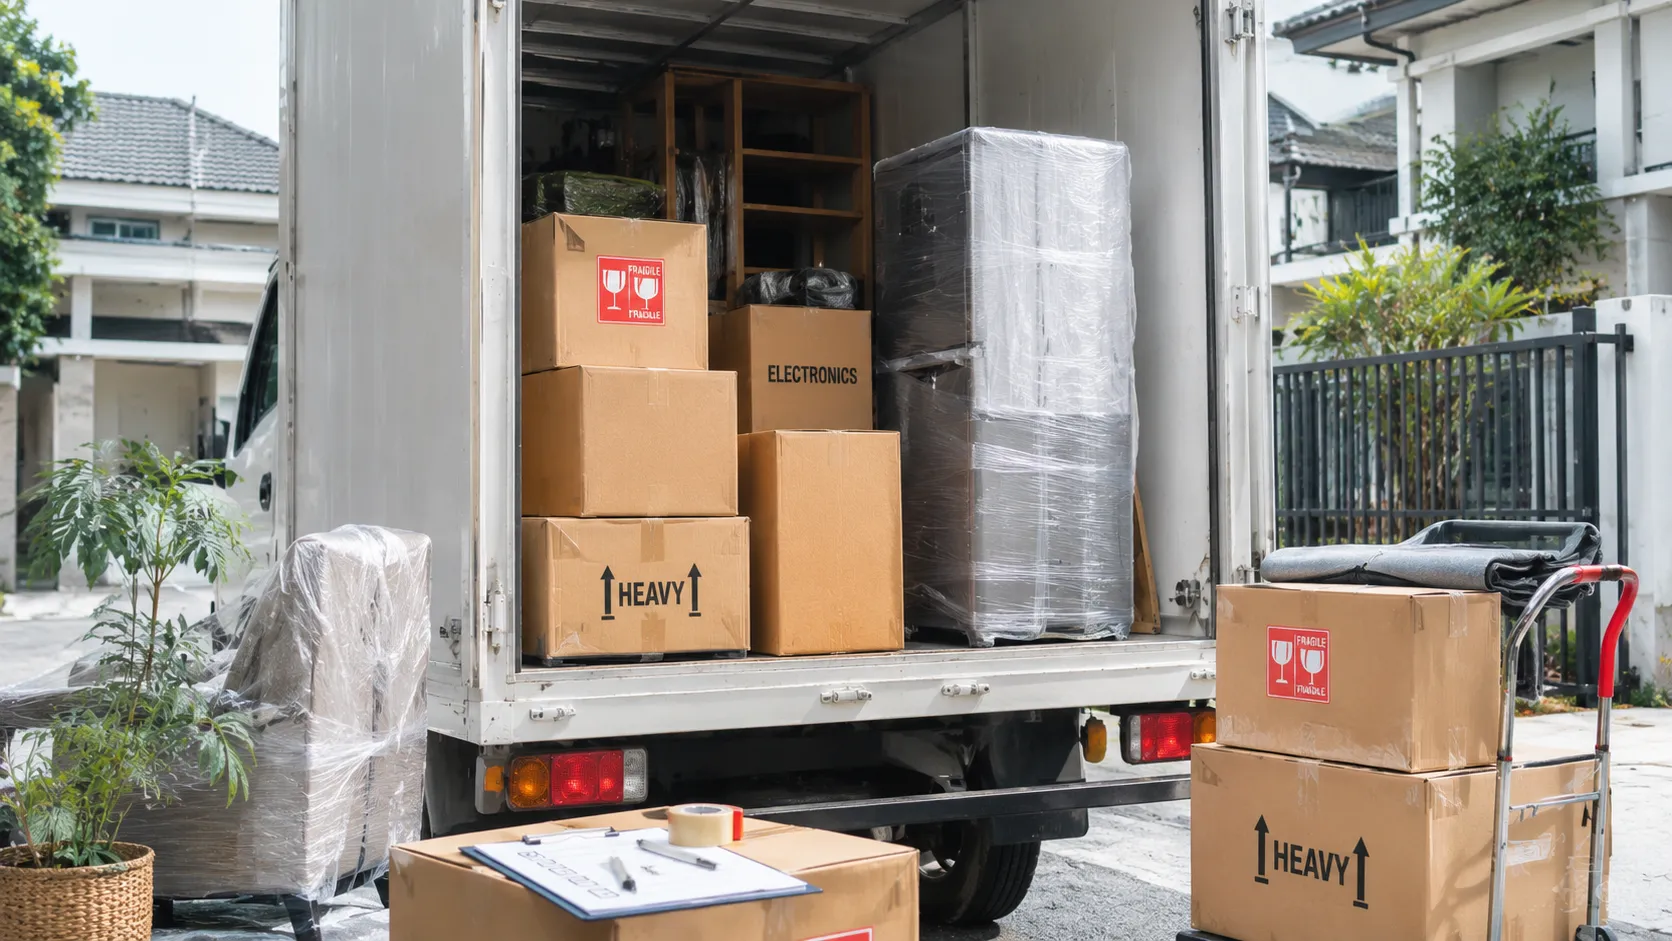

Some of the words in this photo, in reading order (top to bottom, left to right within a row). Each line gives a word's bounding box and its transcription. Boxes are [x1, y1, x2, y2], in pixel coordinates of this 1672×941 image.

[768, 365, 858, 384] ELECTRONICS
[618, 581, 685, 607] HEAVY
[1274, 840, 1350, 886] HEAVY
